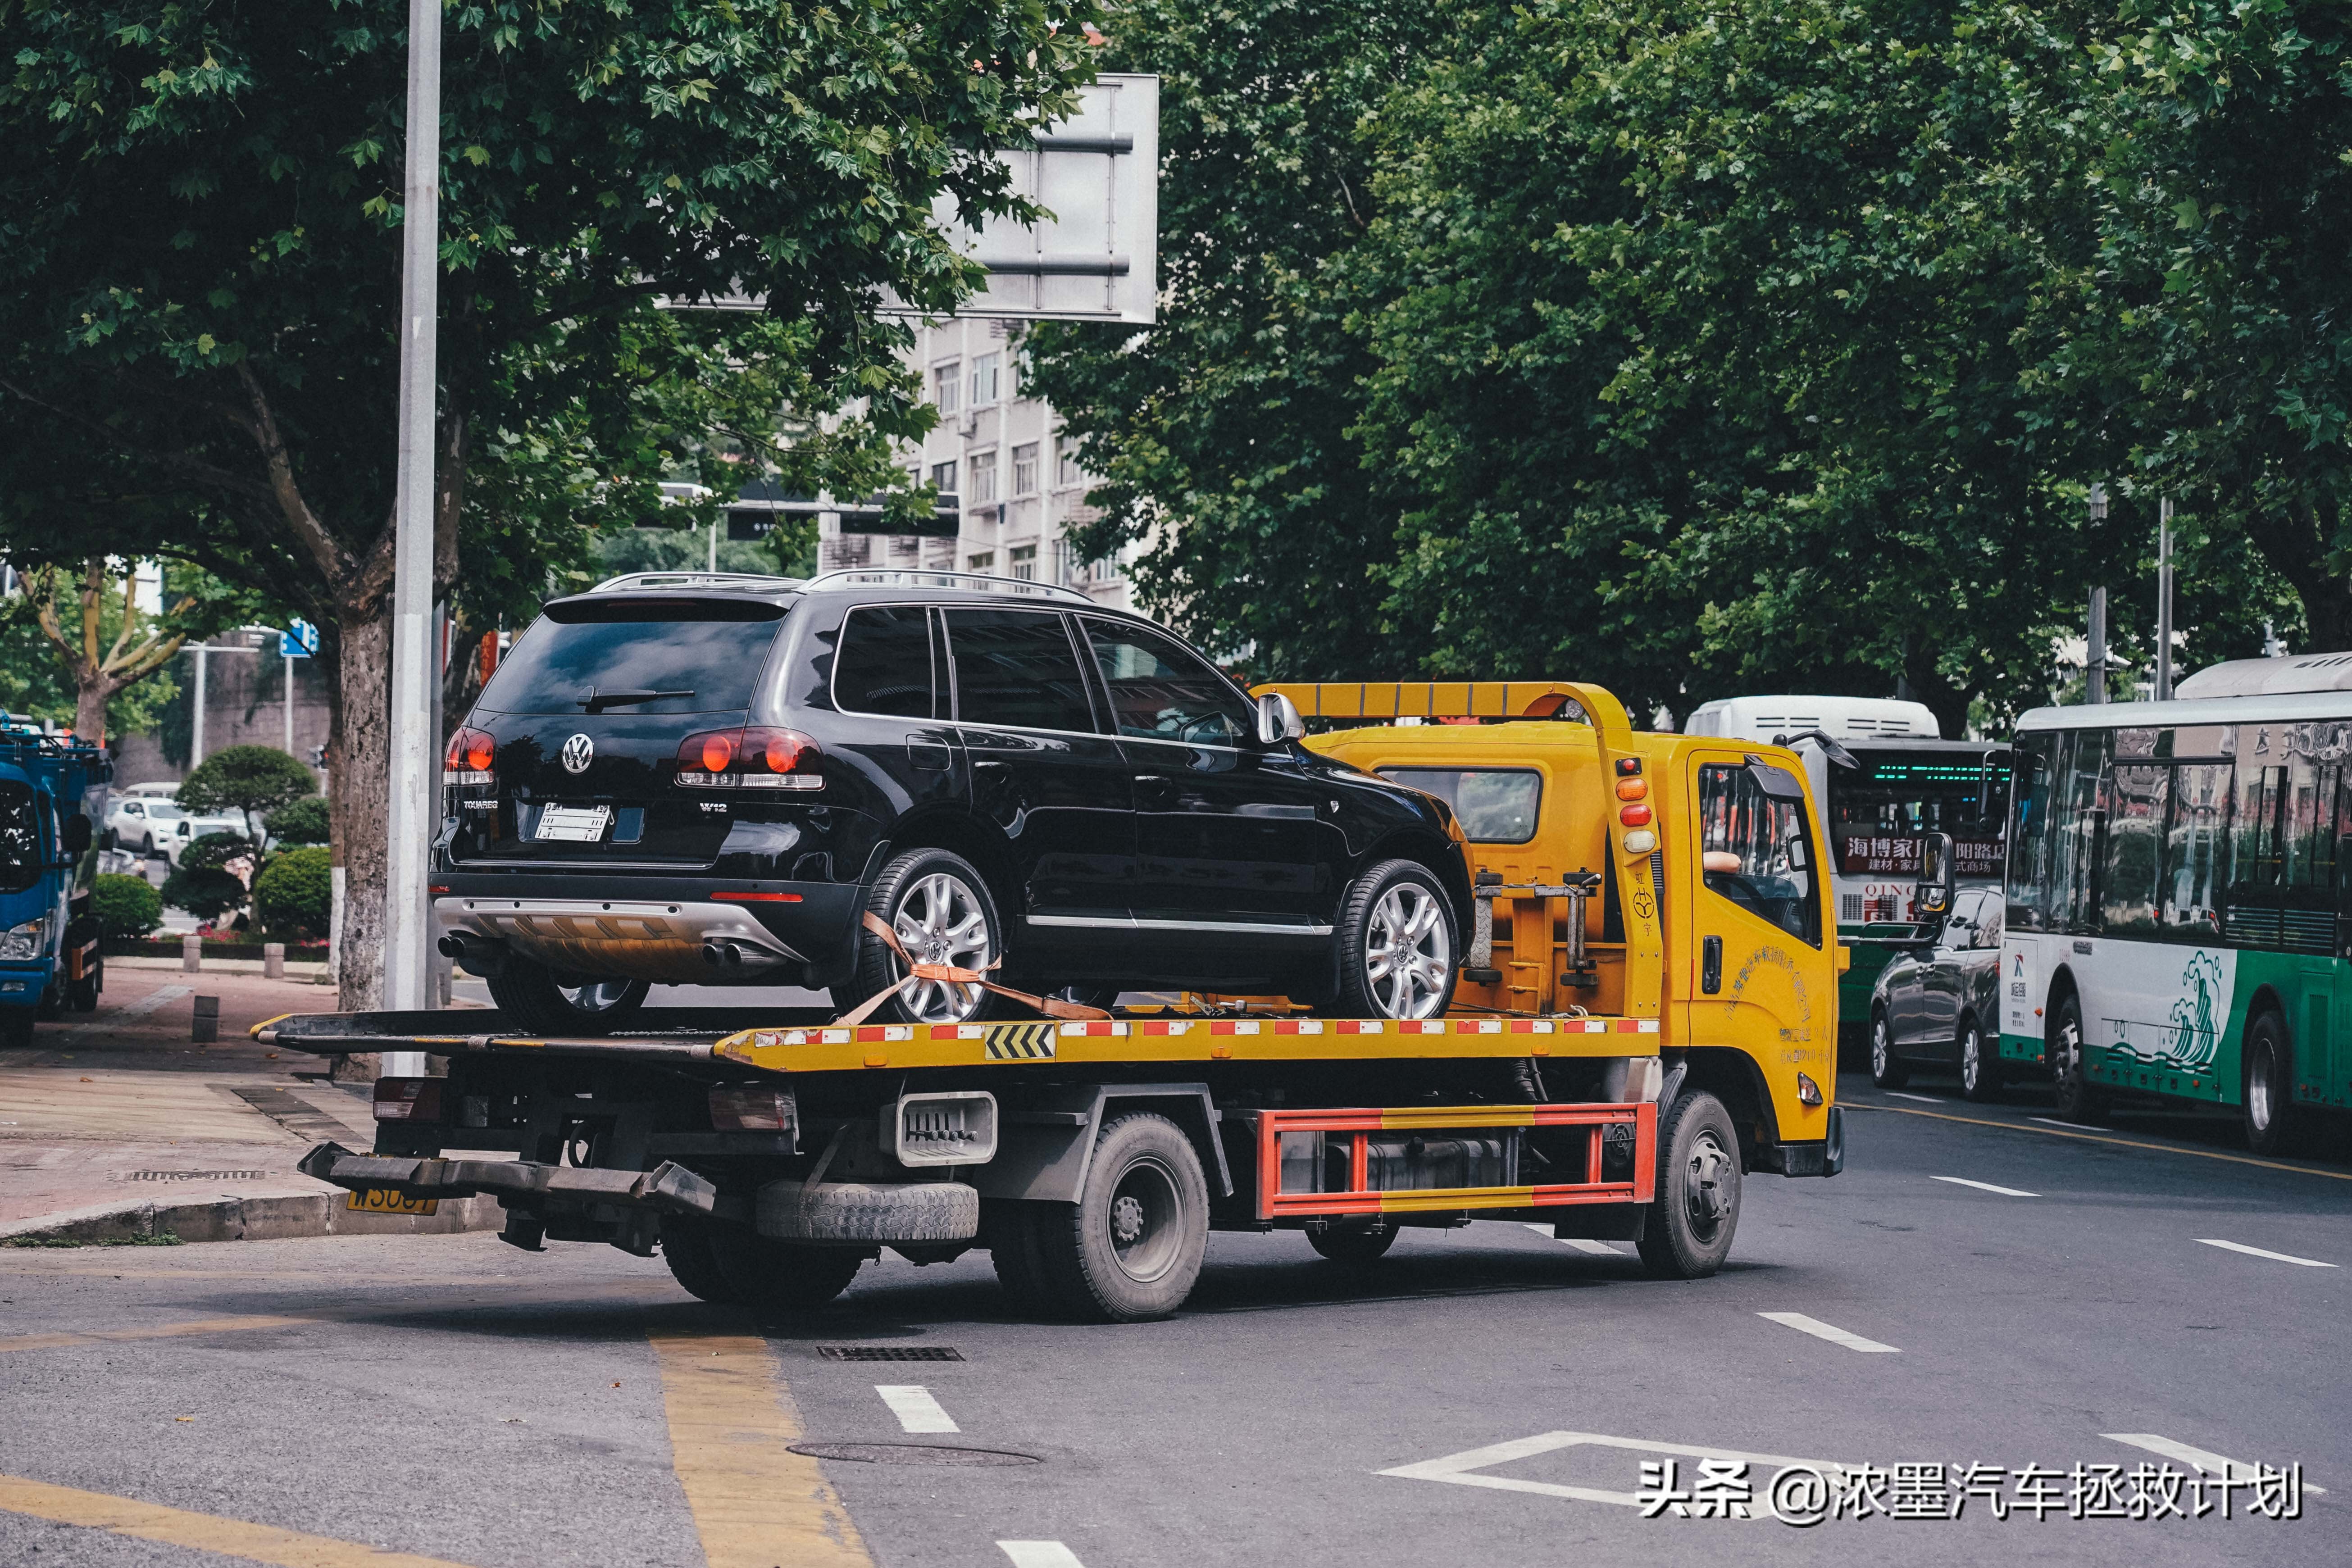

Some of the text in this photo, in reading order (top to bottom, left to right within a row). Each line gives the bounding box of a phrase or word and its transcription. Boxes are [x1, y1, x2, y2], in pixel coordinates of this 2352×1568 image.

[464, 800, 498, 810] TOUAREG
[699, 802, 727, 812] W12
[1643, 923, 1652, 936] 宇
